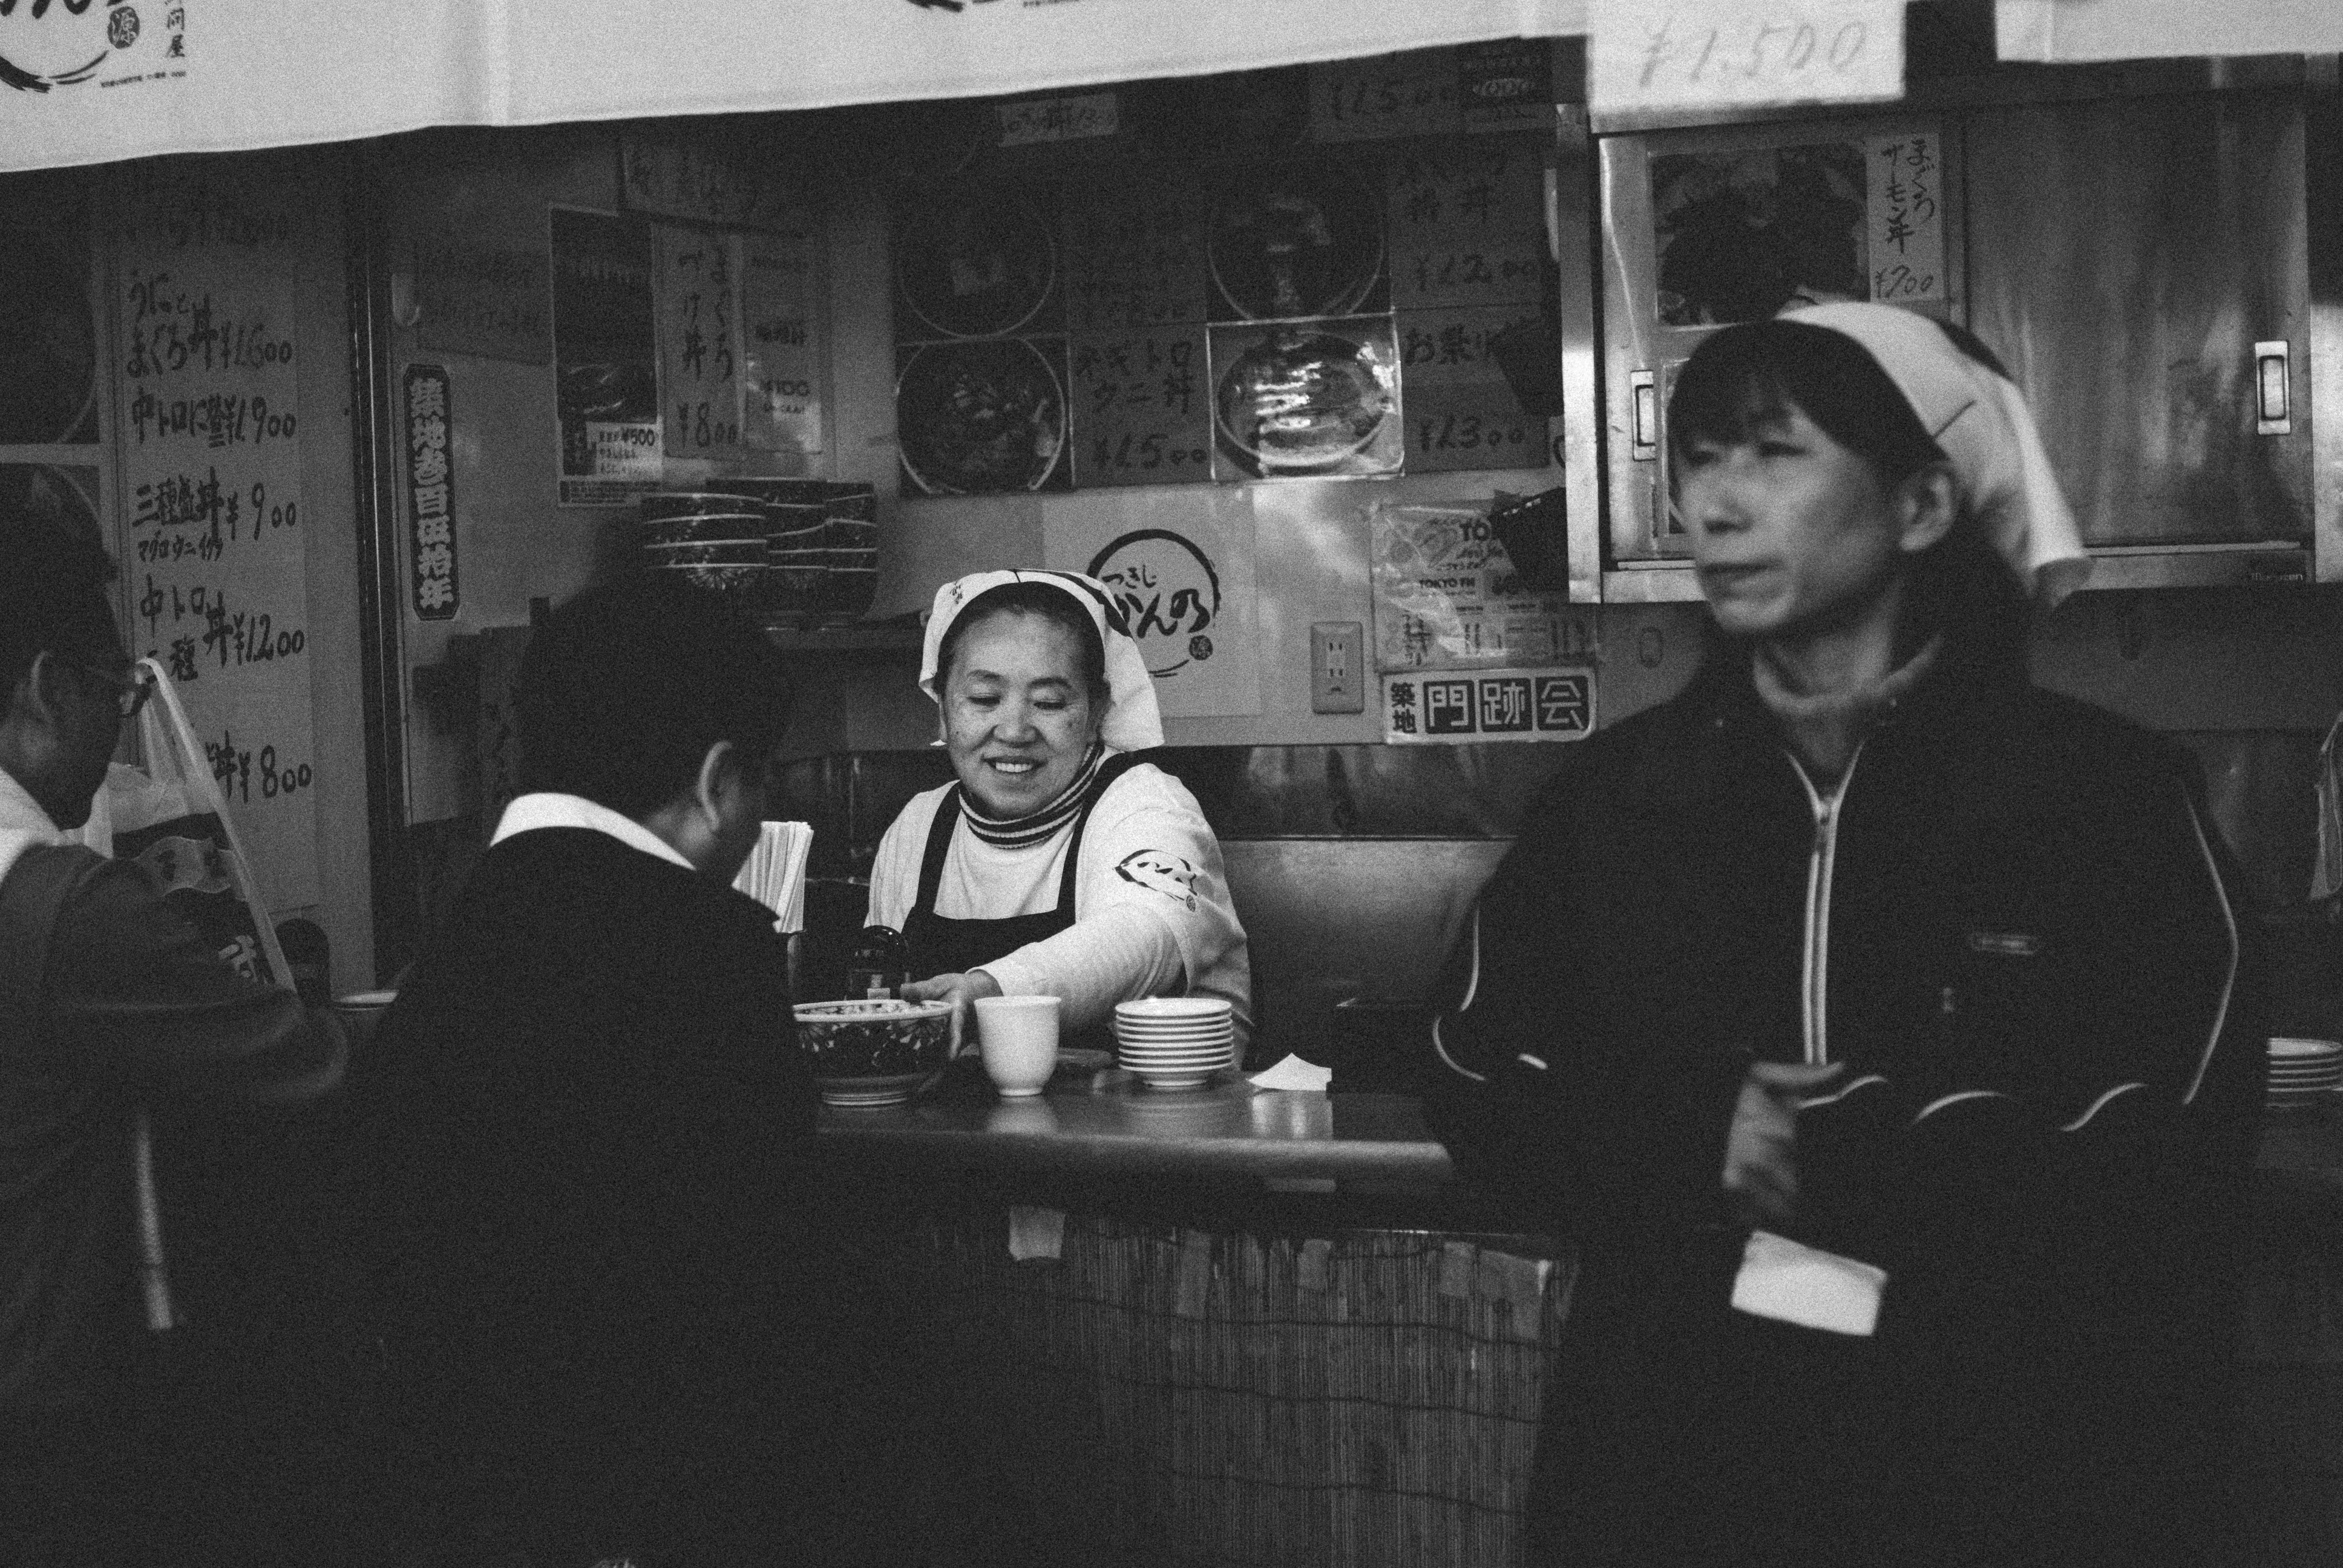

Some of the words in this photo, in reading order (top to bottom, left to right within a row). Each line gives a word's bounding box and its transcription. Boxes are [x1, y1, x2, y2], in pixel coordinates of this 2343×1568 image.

[1389, 681, 1418, 734] 築地
[1427, 679, 1585, 730] 門跡会
